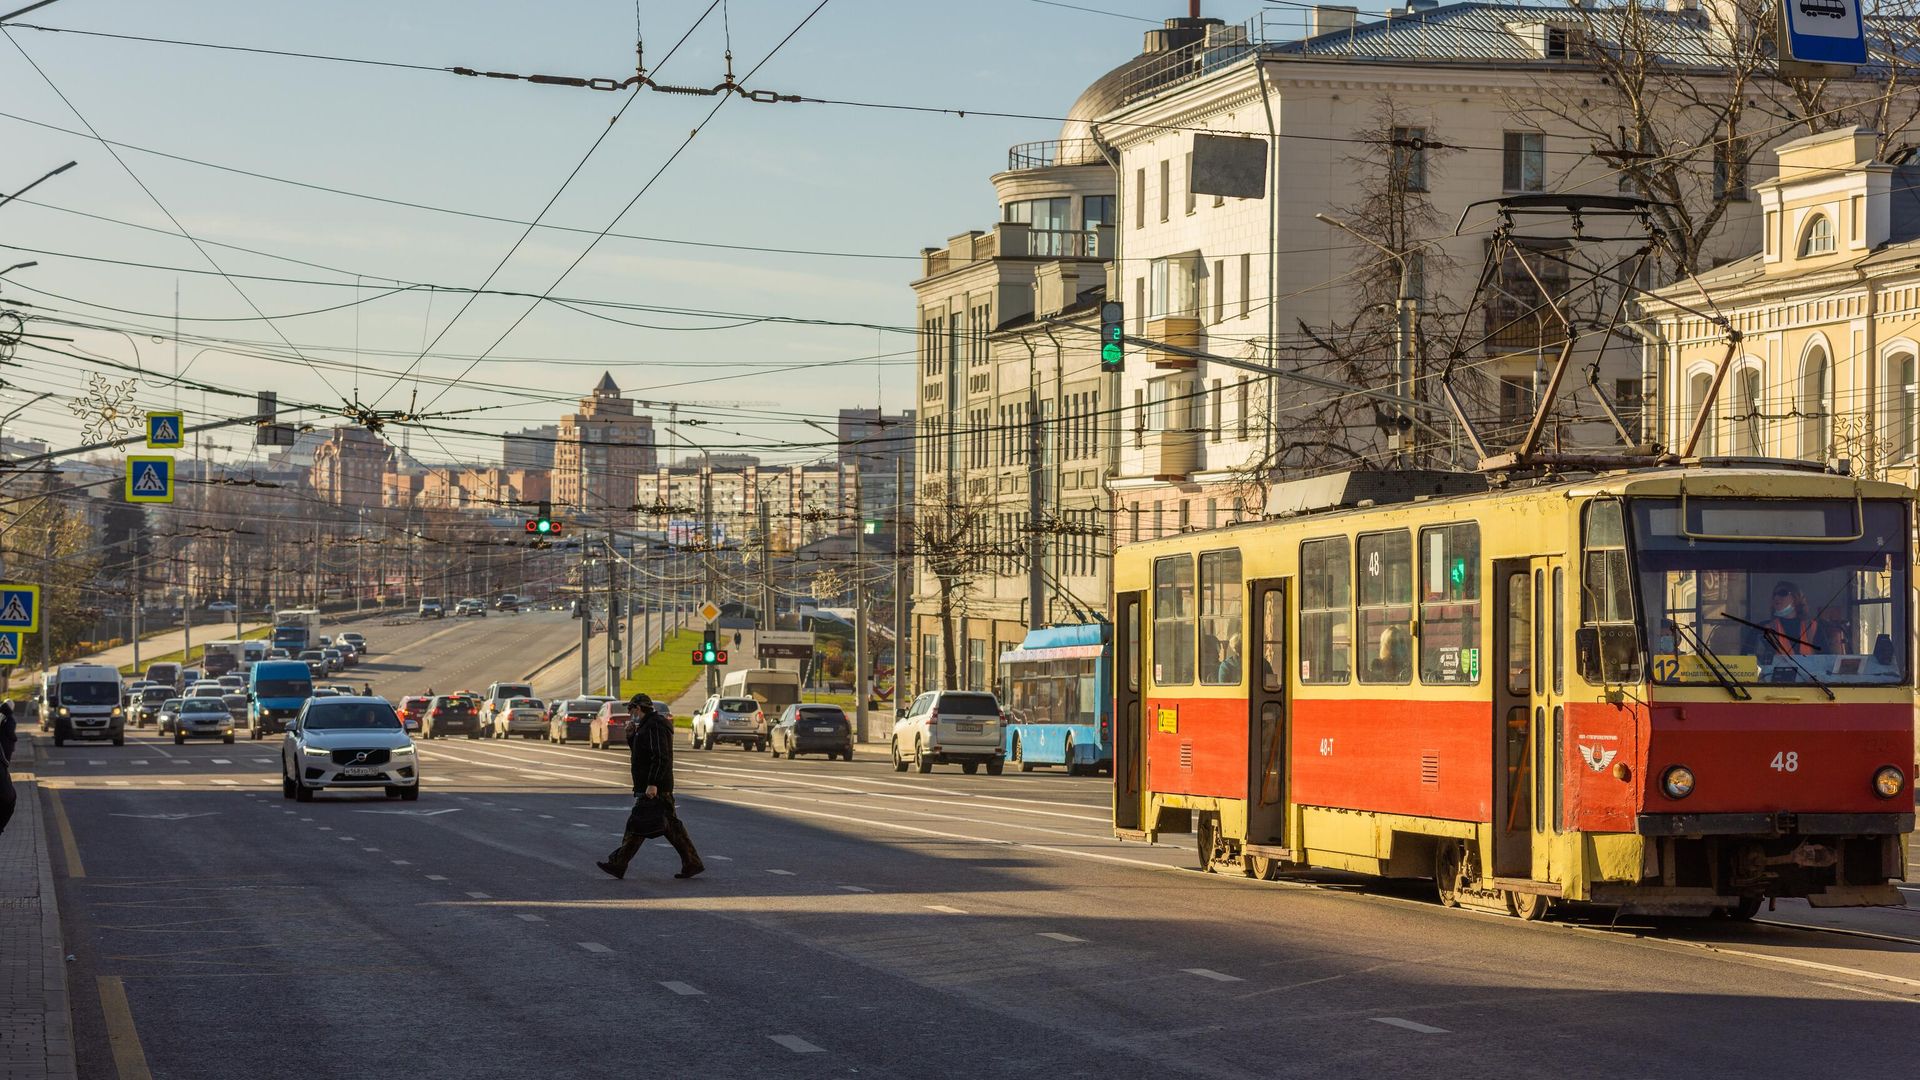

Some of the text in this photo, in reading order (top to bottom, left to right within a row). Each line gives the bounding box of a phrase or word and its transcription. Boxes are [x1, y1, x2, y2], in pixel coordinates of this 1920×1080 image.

[1113, 328, 1121, 340] 2
[1369, 551, 1380, 577] 48
[1655, 659, 1680, 682] 12
[1770, 751, 1799, 772] 48
